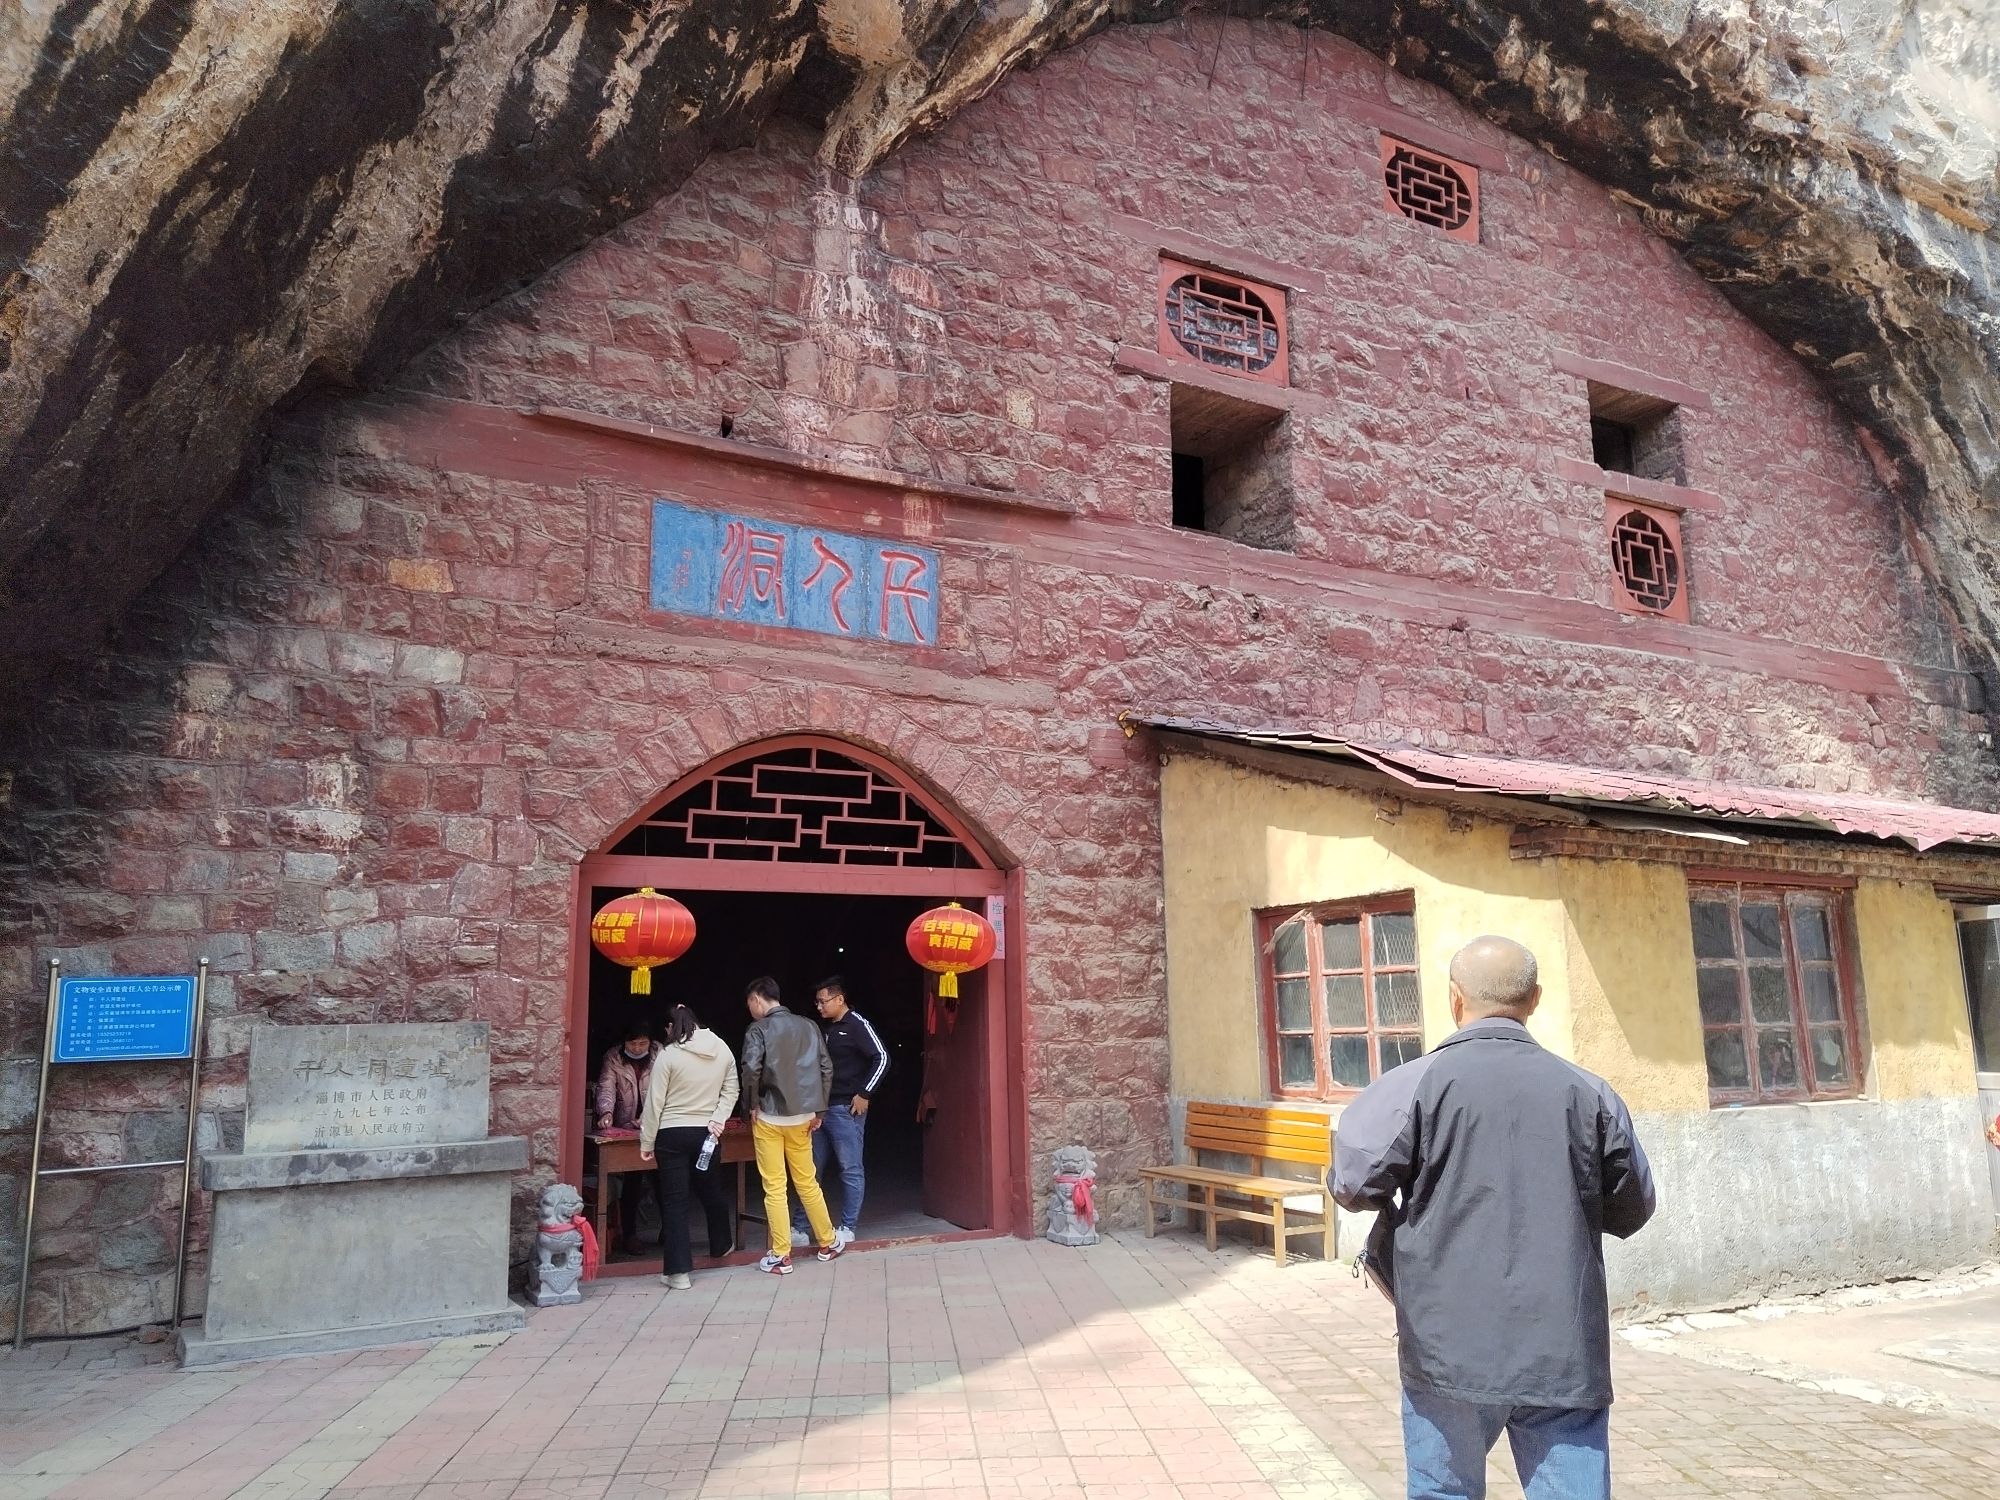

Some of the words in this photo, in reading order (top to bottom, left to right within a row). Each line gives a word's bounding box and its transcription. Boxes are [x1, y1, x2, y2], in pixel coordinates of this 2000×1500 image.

[315, 1086, 428, 1105] 淄博市人民政府
[316, 1103, 427, 1120] 一九九七年公布
[314, 1121, 426, 1139] 沂源县人民政府立
